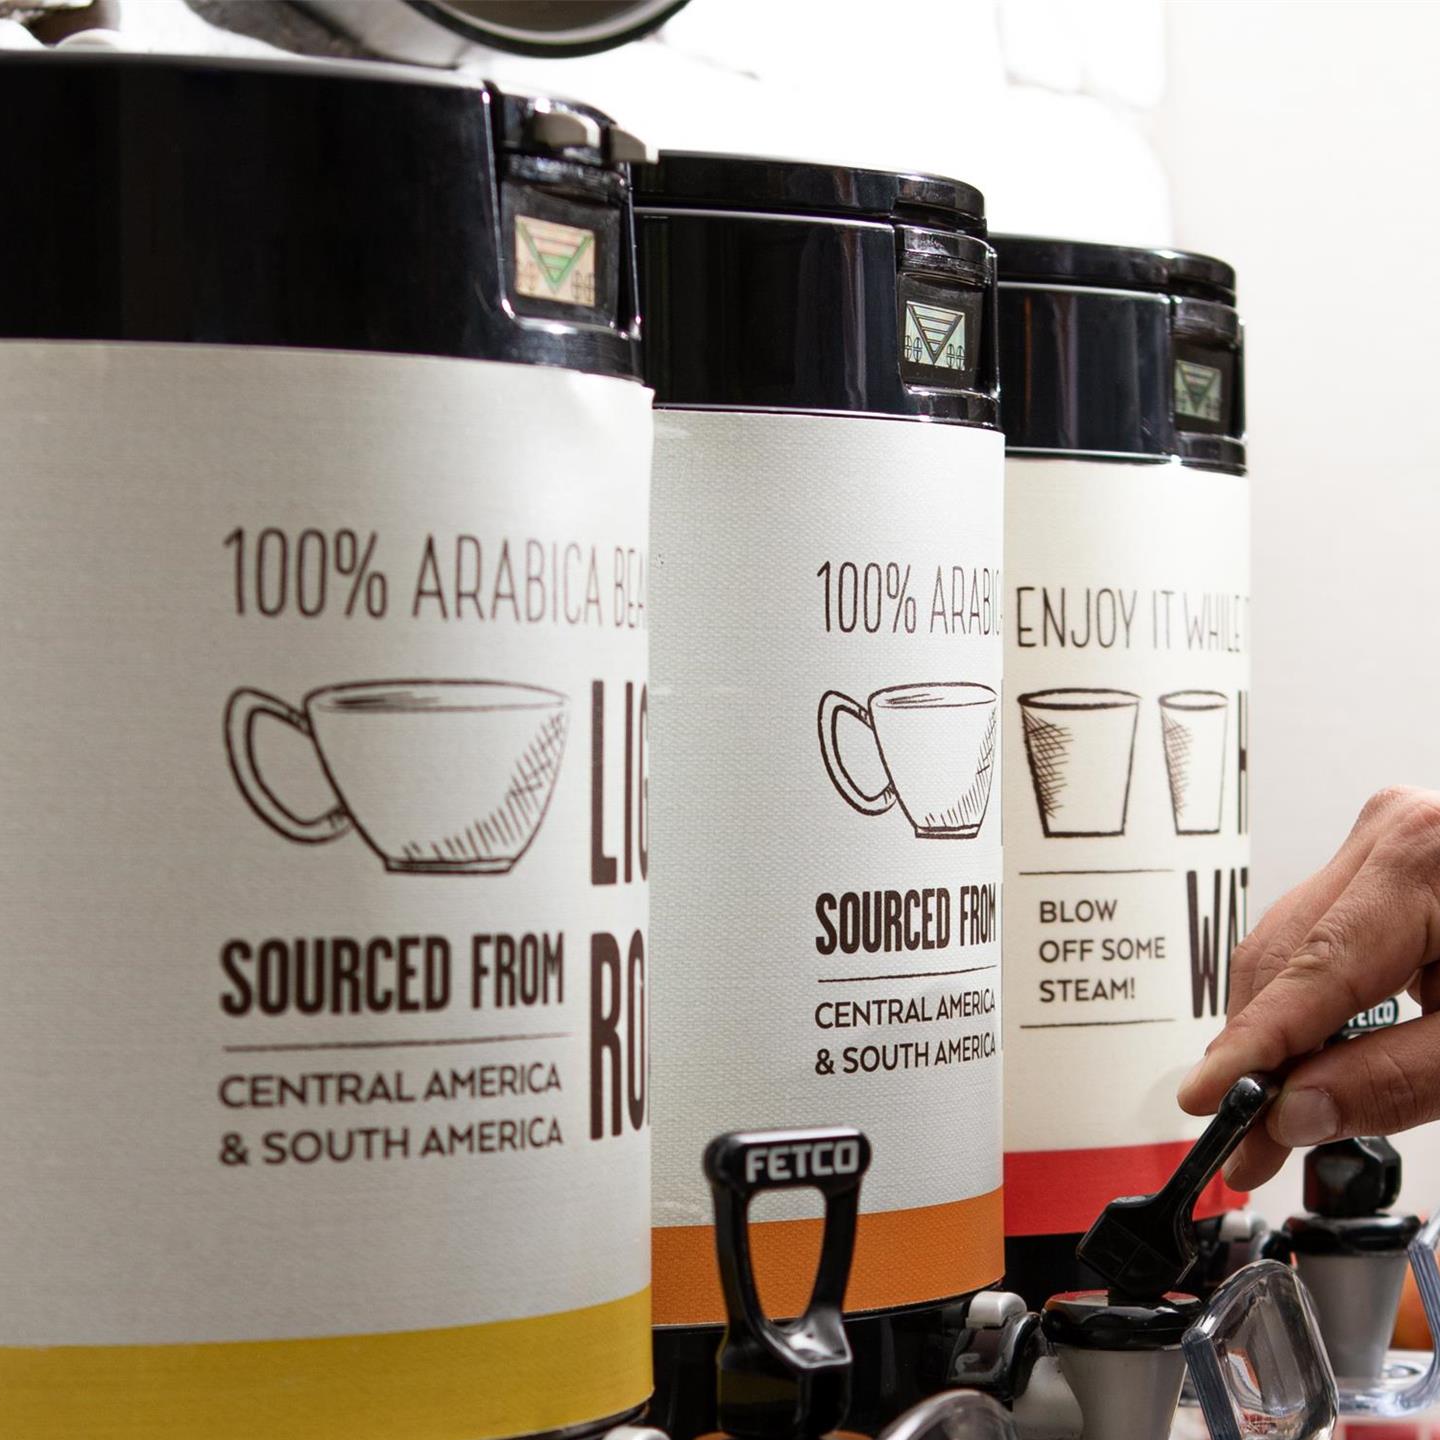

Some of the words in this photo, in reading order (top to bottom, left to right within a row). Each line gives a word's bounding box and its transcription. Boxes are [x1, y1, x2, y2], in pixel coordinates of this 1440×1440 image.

[222, 526, 389, 620] 100%
[411, 533, 602, 626] ARABICA
[817, 560, 917, 634] 100%
[930, 564, 1003, 636] ARABIC
[1016, 585, 1137, 649] ENJOY
[1152, 588, 1177, 650] IT
[814, 887, 951, 956] SOURCED
[960, 882, 997, 947] FROM
[1039, 899, 1118, 924] BLOW
[1039, 940, 1095, 964] OFF
[1101, 936, 1167, 962] SOME
[219, 934, 452, 1018] SOURCED
[470, 931, 565, 1011] FROM
[1039, 977, 1135, 1003] STEAM!
[814, 998, 933, 1030] CENTRAL
[935, 988, 996, 1021] AMERICA
[814, 1049, 836, 1076] &
[842, 1042, 929, 1075] SOUTH
[933, 1032, 996, 1067] AMERICA
[218, 1070, 416, 1110] CENTRAL
[422, 1062, 563, 1102] AMERICA
[219, 1132, 250, 1168] &
[262, 1126, 410, 1167] SOUTH
[418, 1116, 564, 1159] AMERICA
[745, 1139, 860, 1184] FETCO
